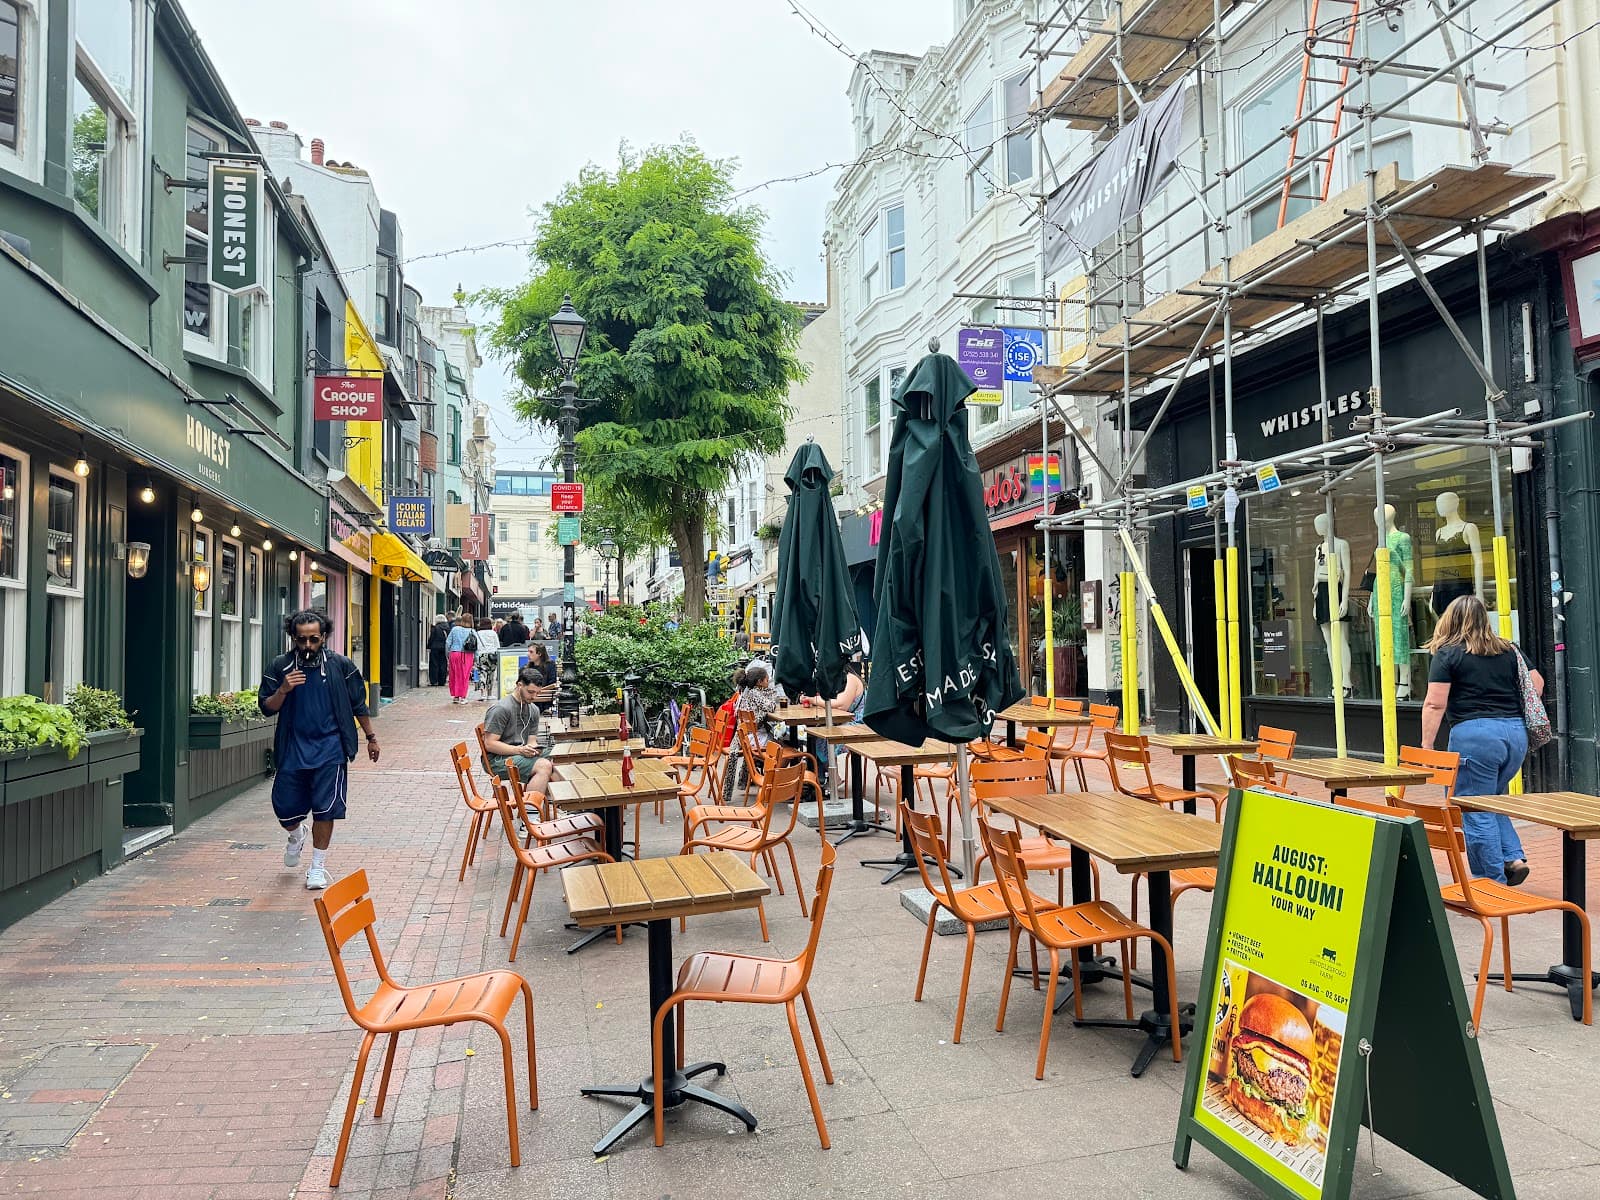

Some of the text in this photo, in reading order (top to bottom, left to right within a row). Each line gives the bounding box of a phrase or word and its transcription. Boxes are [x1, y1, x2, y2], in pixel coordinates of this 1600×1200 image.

[223, 175, 247, 277] HONEST
[1014, 352, 1030, 361] ISE
[340, 381, 356, 389] The
[321, 387, 376, 404] CROQUE
[330, 405, 368, 416] SHOP
[1260, 390, 1362, 438] WHISTLES
[186, 413, 231, 470] HONEST
[396, 503, 426, 512] ICONIC
[396, 511, 426, 520] ITALIAN
[396, 519, 426, 527] GELATO
[1272, 844, 1328, 876] AUGUST:
[1252, 861, 1344, 912] HALLOUMI
[1271, 895, 1316, 920] YOUR WAY
[1232, 931, 1261, 948] HONEST BEEF
[1231, 939, 1265, 959] FRIED CHICKEN
[1308, 983, 1320, 993] AUG
[1325, 989, 1333, 999] 02
[1333, 994, 1348, 1005] SEPT
